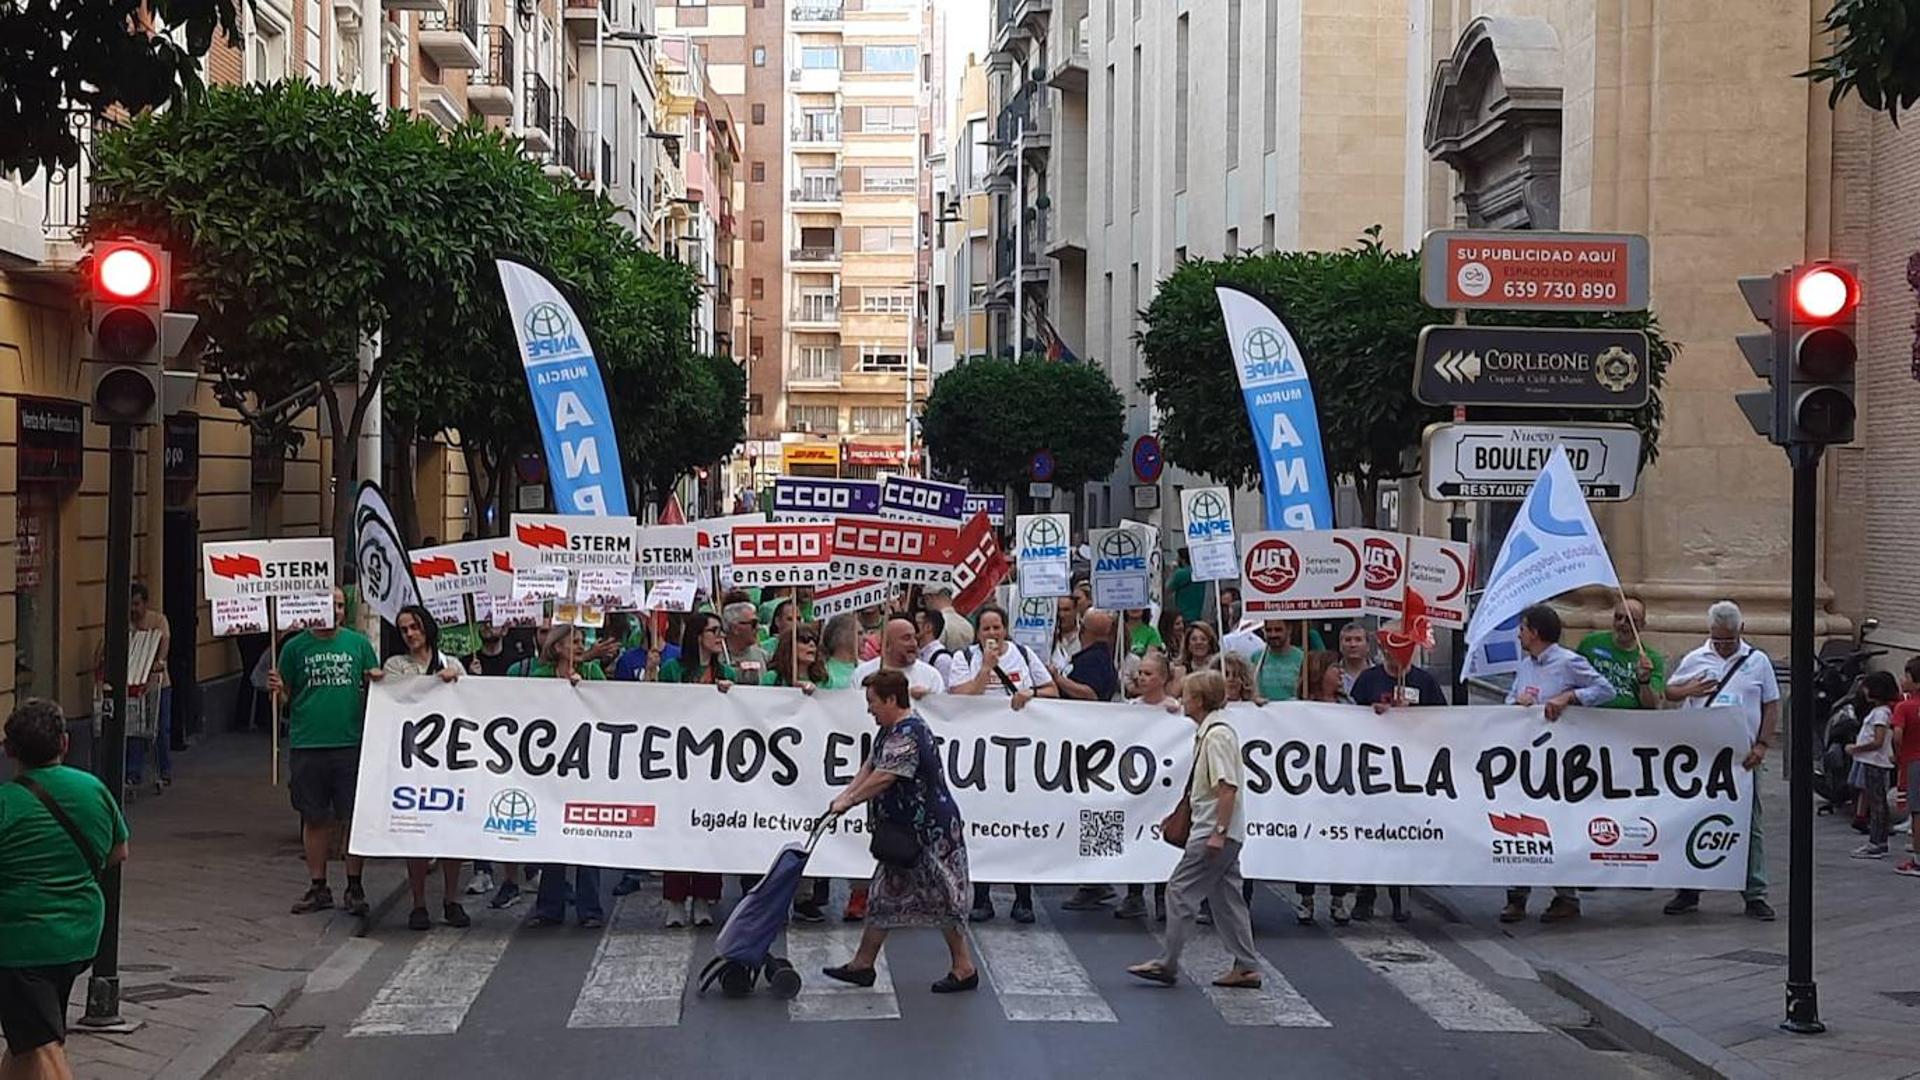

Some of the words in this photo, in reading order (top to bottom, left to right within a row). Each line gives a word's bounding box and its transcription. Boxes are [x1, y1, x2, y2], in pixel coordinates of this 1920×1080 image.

[1457, 248, 1478, 260] SU
[1481, 248, 1574, 262] PUBLICIDAD
[1577, 247, 1617, 263] AQUÍ
[1503, 267, 1549, 278] ESPACIO
[1503, 281, 1538, 298] 639
[1542, 282, 1576, 298] 730
[1581, 282, 1617, 299] 890
[1484, 348, 1590, 372] CORLEONE
[1510, 428, 1555, 443] Nuevo
[1475, 446, 1590, 471] BOULEVRD
[776, 486, 850, 508] CCOO
[884, 483, 942, 511] CCOO
[963, 499, 988, 512] OO
[1188, 520, 1232, 536] ANPE
[570, 535, 631, 552] STERM
[734, 532, 821, 559] CCOO
[836, 525, 923, 554] CCOO
[540, 551, 631, 566] INTERSINDICAL
[642, 548, 694, 563] STERM
[1021, 546, 1068, 558] ANPE
[1253, 547, 1294, 569] UGT
[265, 561, 329, 578] STERM
[829, 558, 952, 583] enseñanza
[1095, 557, 1146, 571] ANPE
[236, 578, 330, 594] INTERSINDICAL
[1311, 600, 1344, 610] Murcia
[400, 713, 802, 786] RESCATEMOS
[935, 735, 1173, 796] UTURO:
[1242, 738, 1458, 800] SCUELA
[1475, 731, 1739, 803] PÚBLICA
[568, 807, 628, 822] CCOO
[484, 816, 537, 833] ANPE
[561, 825, 633, 839] enseñanza
[691, 809, 747, 832] bajada
[971, 820, 1050, 838] recortes
[1319, 825, 1349, 840] +55
[1354, 818, 1444, 841] reducción
[1492, 840, 1554, 855] STERM
[1696, 830, 1741, 852] CSIF
